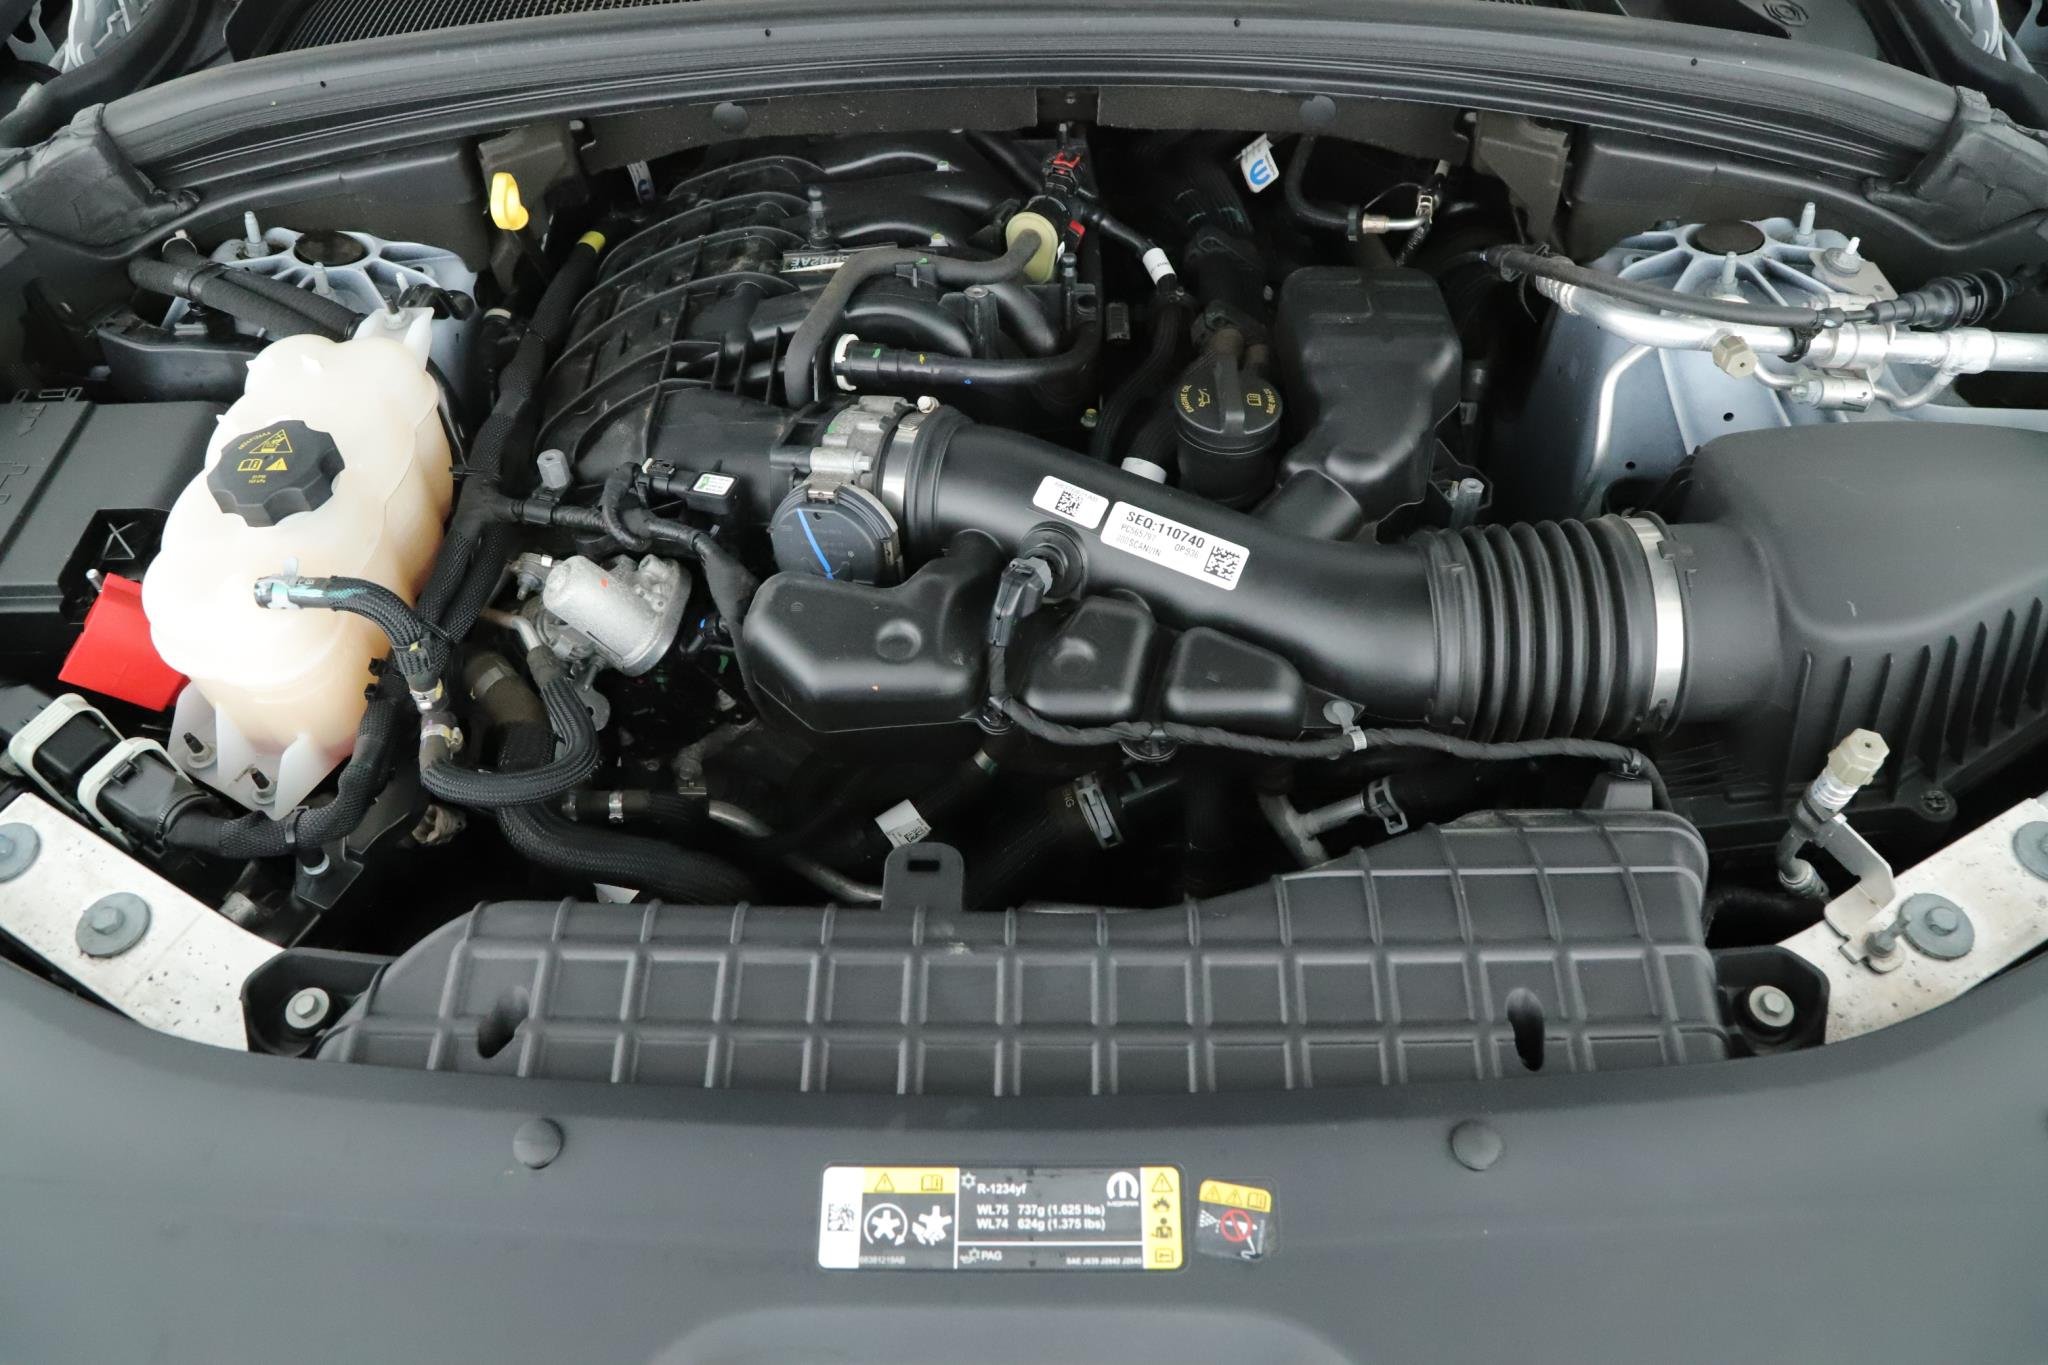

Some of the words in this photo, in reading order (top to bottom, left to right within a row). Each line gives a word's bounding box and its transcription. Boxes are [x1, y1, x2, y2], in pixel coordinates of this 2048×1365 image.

[1126, 511, 1205, 549] SEQ:110740
[977, 1183, 1027, 1197] R-1234yf
[976, 1204, 1009, 1215] WL75
[1017, 1204, 1046, 1218] 737g
[1047, 1204, 1082, 1217] (1.625
[1083, 1204, 1105, 1217] lbs)
[976, 1218, 1009, 1229] WL74
[1017, 1218, 1046, 1231] 624g
[1047, 1218, 1082, 1231] (1.375
[1083, 1218, 1105, 1231] lbs)
[981, 1250, 1002, 1261] PAG
